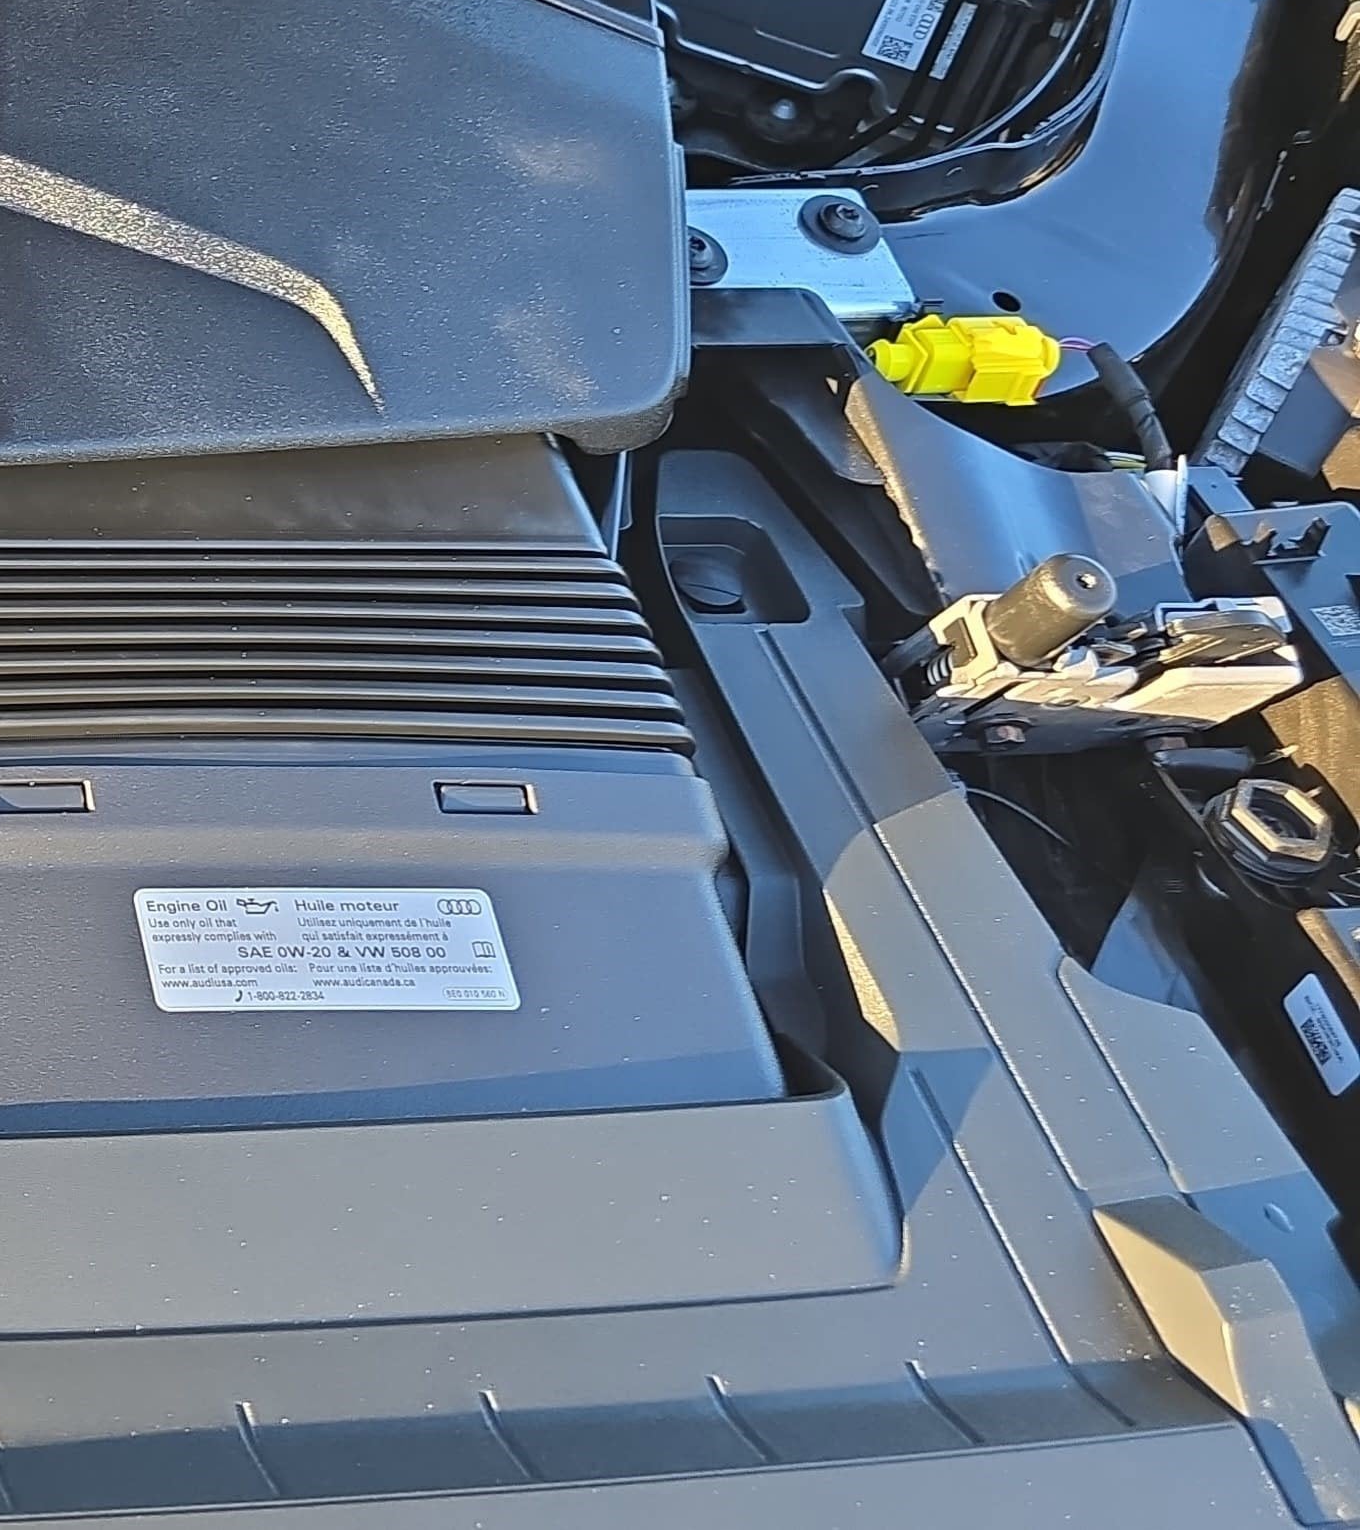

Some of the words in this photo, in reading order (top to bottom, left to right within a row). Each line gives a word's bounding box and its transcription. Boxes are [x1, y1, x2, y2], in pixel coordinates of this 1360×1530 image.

[145, 900, 201, 913] Engine
[204, 899, 227, 910] Oil
[293, 899, 335, 910] Huile
[338, 900, 400, 910] moteur
[147, 918, 169, 927] Use
[171, 918, 196, 928] only
[198, 918, 212, 927] oil
[214, 918, 236, 926] that
[297, 918, 336, 926] Utilisez
[337, 918, 402, 928] uniquement
[403, 918, 417, 927] de
[151, 932, 202, 942] expressly
[203, 932, 251, 942] complies
[253, 931, 276, 940] with
[301, 931, 319, 941] qui
[321, 931, 363, 940] satisfait
[237, 946, 273, 957] SAE
[276, 946, 332, 957] 0W-20
[336, 946, 351, 957] &
[355, 946, 386, 957] VW
[390, 946, 421, 957] 508
[424, 946, 446, 957] 00
[157, 964, 176, 973] For
[187, 964, 205, 973] list
[206, 964, 218, 973] of
[220, 963, 272, 974] approved
[273, 963, 297, 972] oils:
[308, 963, 334, 972] Pour
[359, 963, 382, 972] liste
[161, 978, 258, 987] www.audiusa.com
[312, 977, 415, 986] www.audicanada.ca
[247, 990, 324, 1000] 1-800-822-2834
